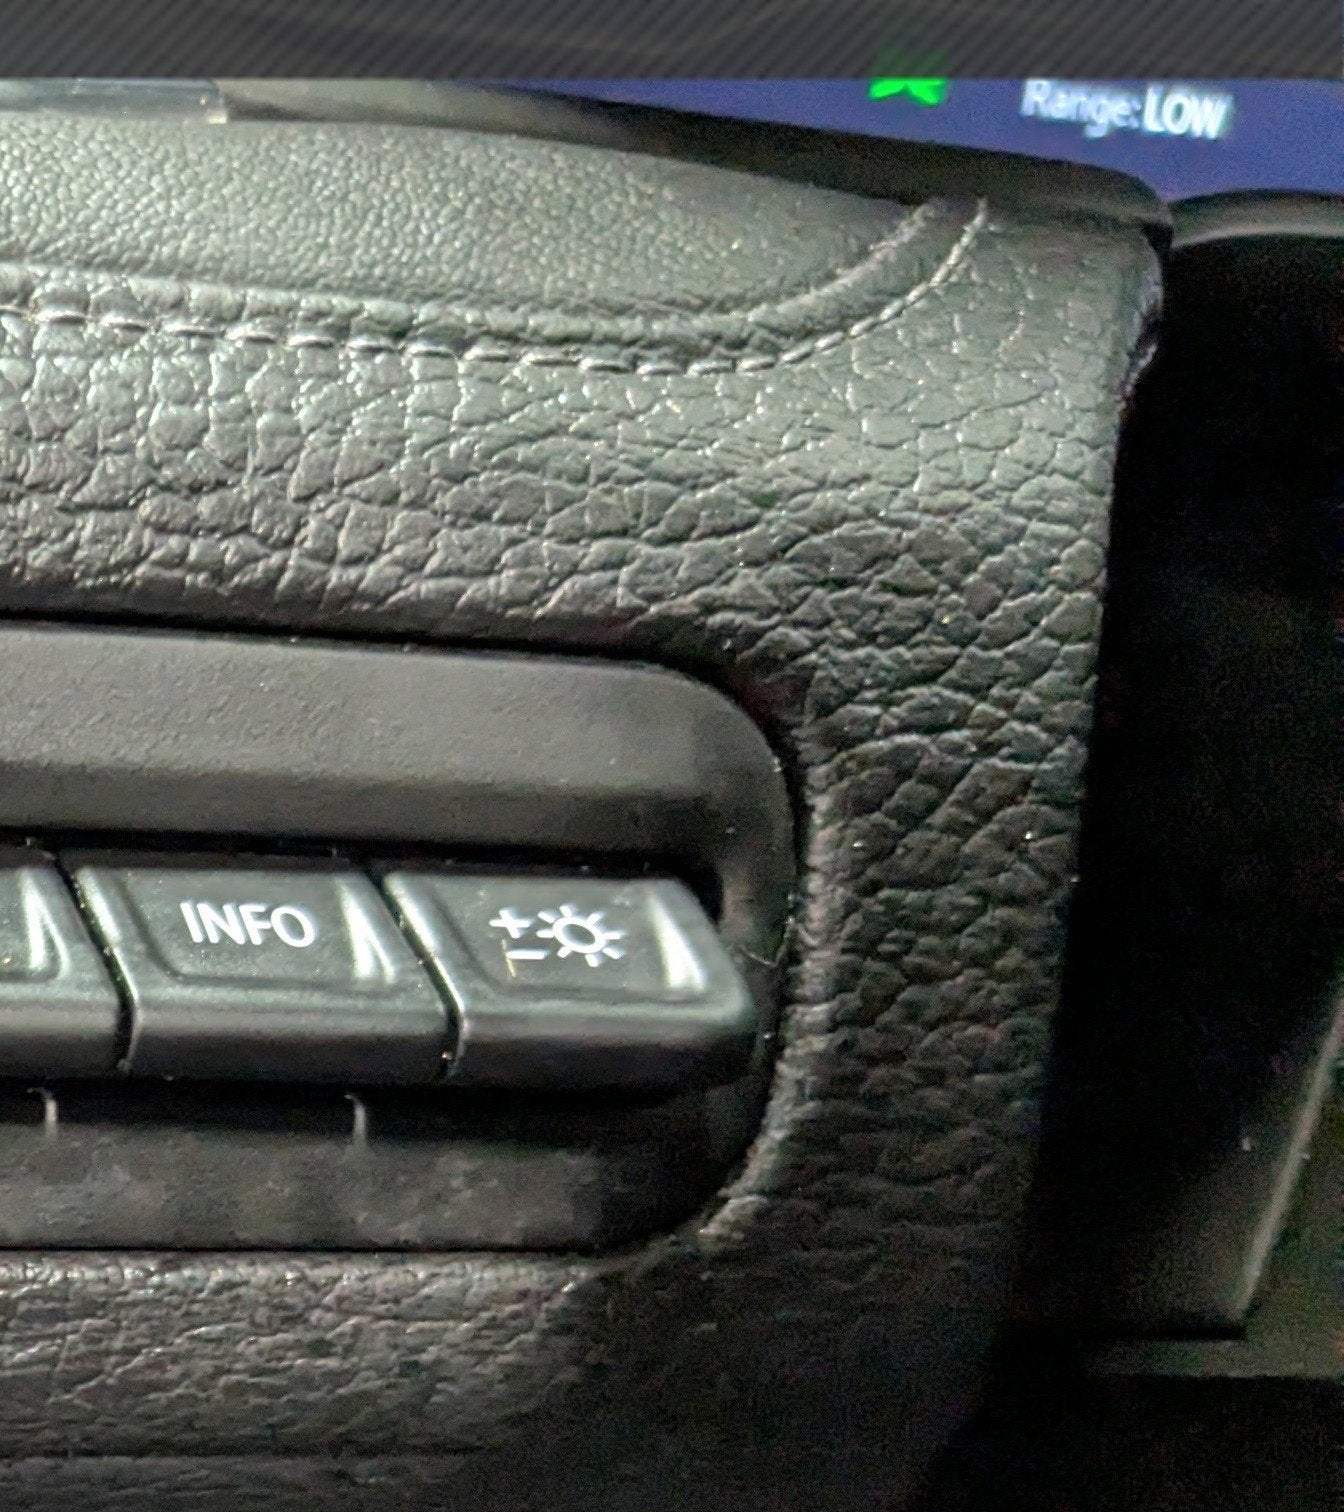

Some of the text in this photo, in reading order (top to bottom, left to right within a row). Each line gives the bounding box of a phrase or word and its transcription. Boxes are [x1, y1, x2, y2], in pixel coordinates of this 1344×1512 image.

[1021, 78, 1233, 139] Range: LOW
[179, 898, 315, 949] INFO
